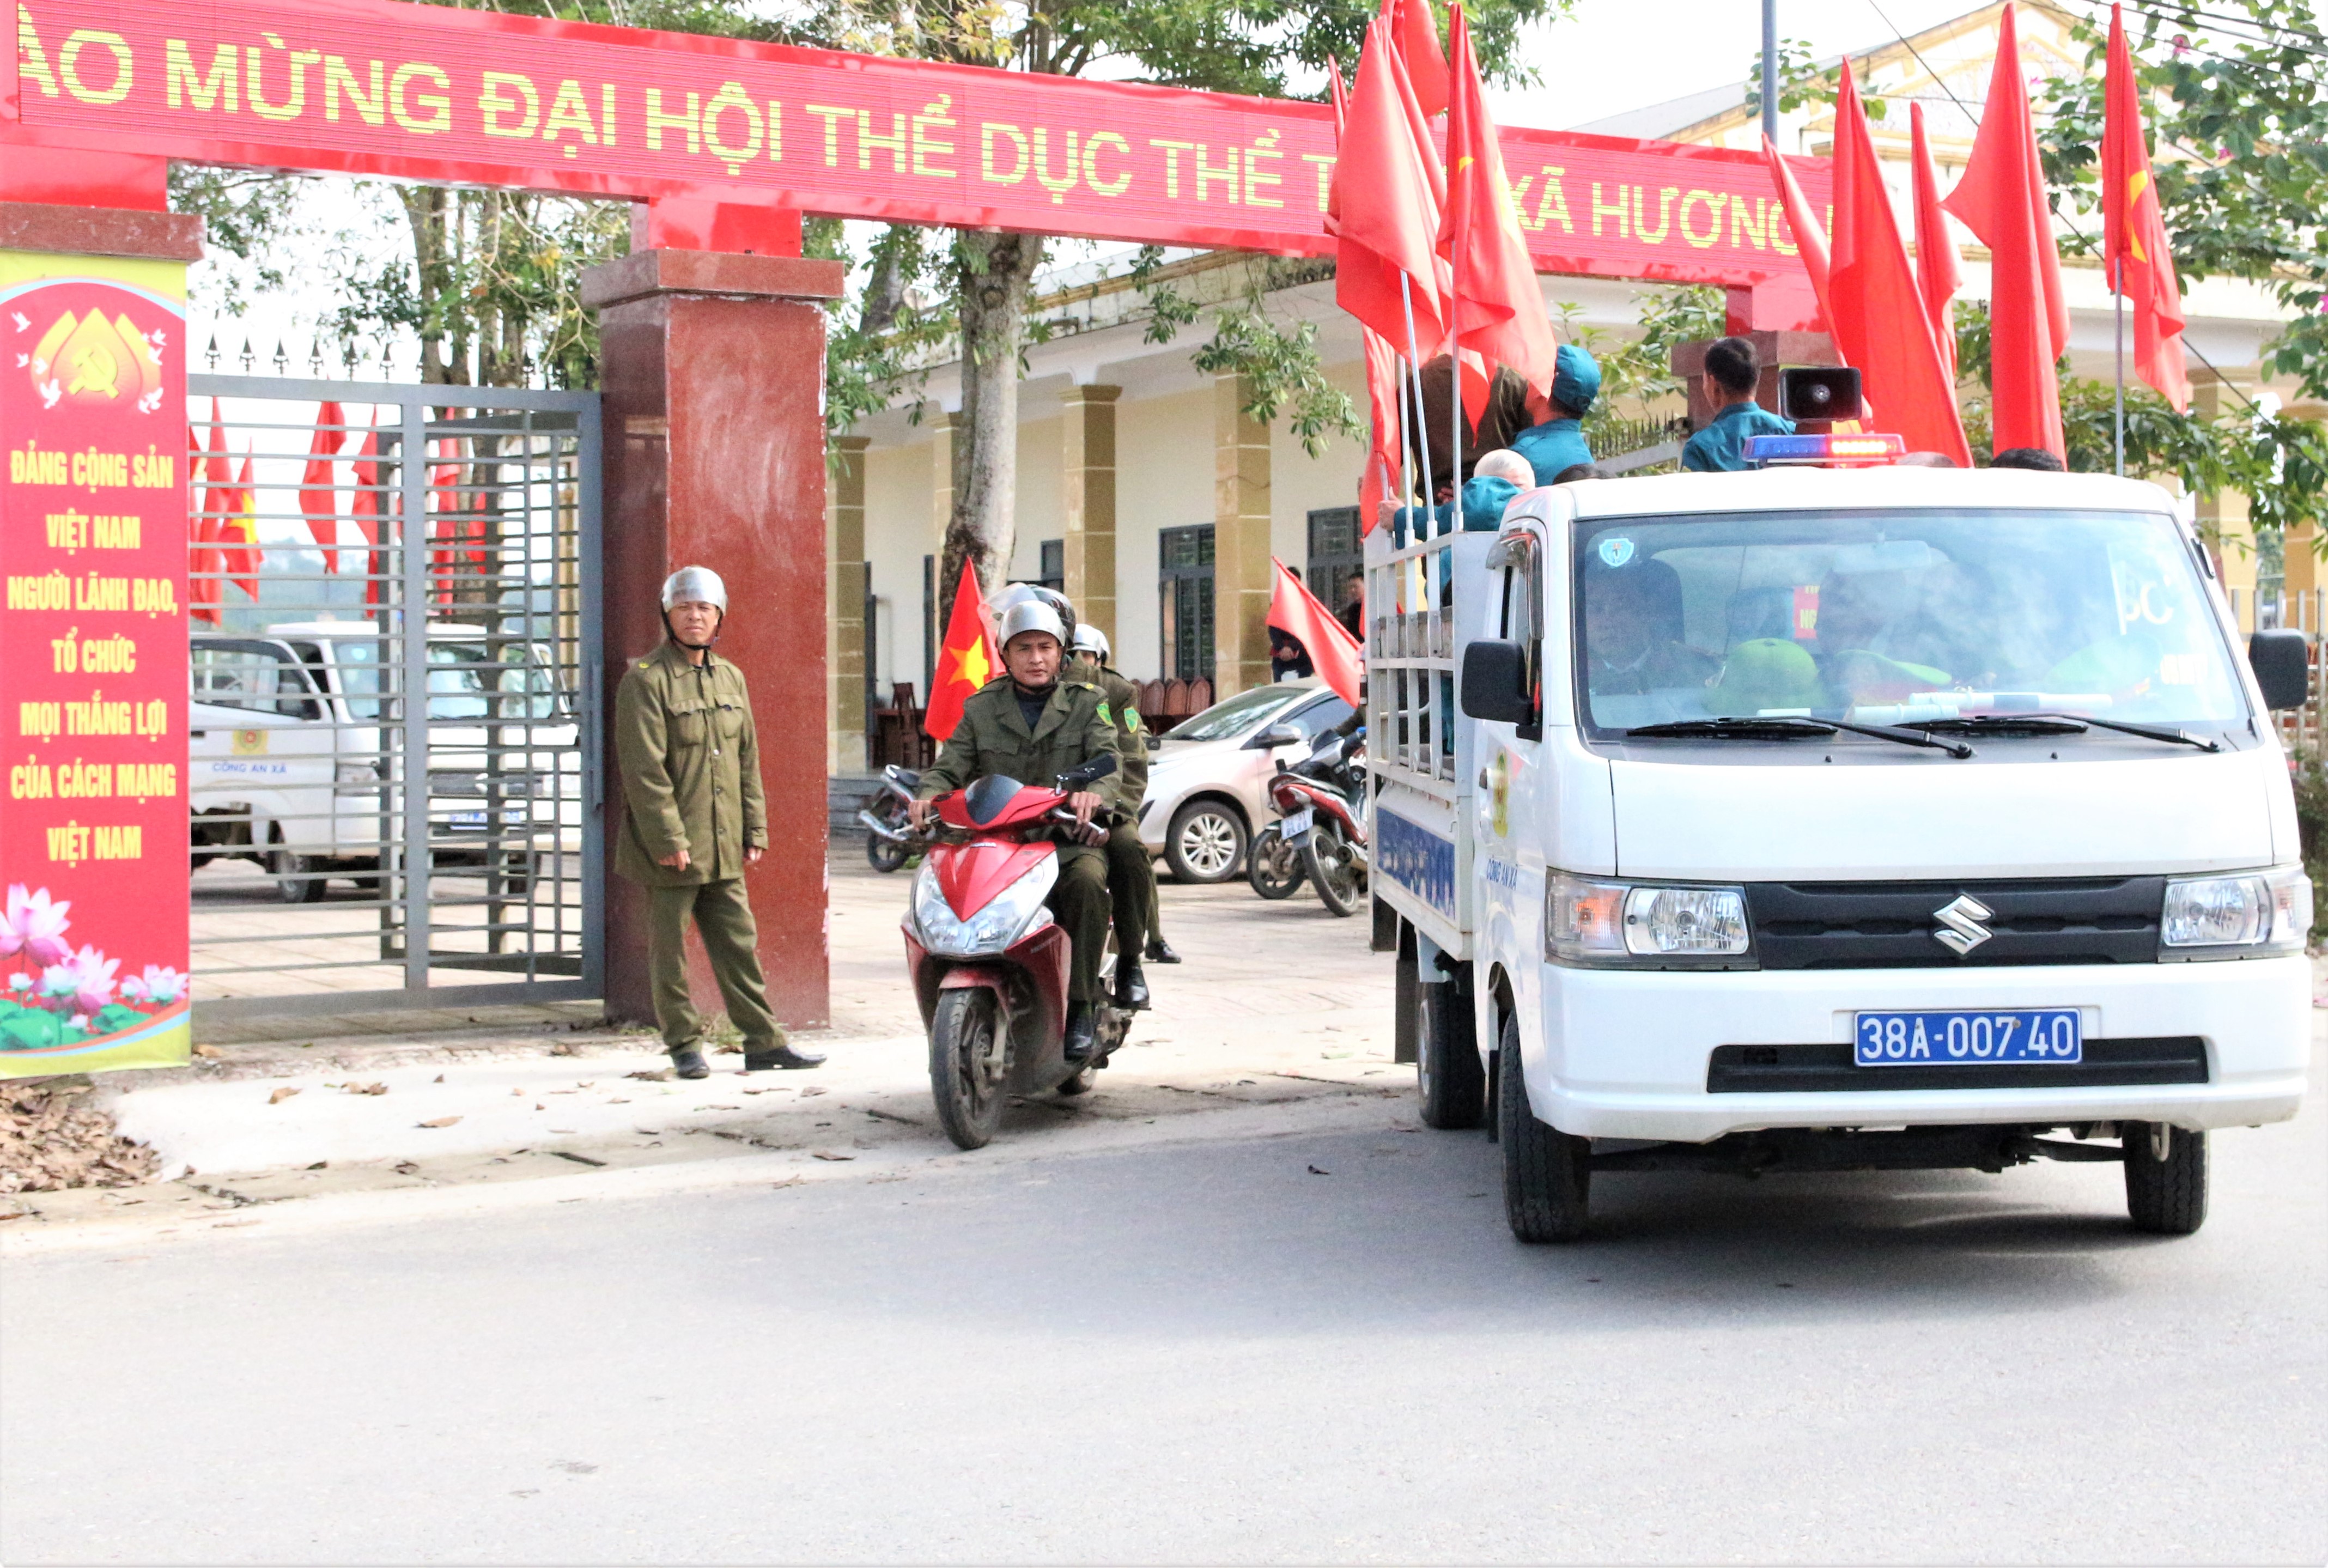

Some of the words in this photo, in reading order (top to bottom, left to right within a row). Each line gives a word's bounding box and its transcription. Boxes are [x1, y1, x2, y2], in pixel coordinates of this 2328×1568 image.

[166, 32, 451, 134] MỪNG
[478, 71, 616, 158] ĐẠI
[646, 81, 782, 175] HỘI
[806, 94, 957, 178] THỂ
[982, 122, 1133, 204] DỤC
[1150, 129, 1284, 208] THỂ
[10, 440, 68, 485] ĐẢNG
[72, 446, 127, 493] CỘNG
[133, 445, 173, 488] SẢN
[46, 508, 89, 555] VIỆT
[94, 515, 141, 549] NAM
[8, 569, 70, 610] NGƯỜI
[76, 572, 128, 611] LÃNH
[133, 578, 178, 618] ĐẠO,
[51, 627, 77, 673] TỔ
[82, 633, 136, 673] CHỨC
[21, 702, 60, 743] MỌI
[65, 690, 131, 735] THẮNG
[136, 699, 167, 742] LỢI
[10, 755, 53, 799] CỦA
[58, 758, 112, 798] CÁCH
[117, 763, 176, 804] MẠNG
[47, 821, 90, 867] VIỆT
[95, 826, 141, 859] NAM
[1862, 1016, 2073, 1059] 38A-007.40
